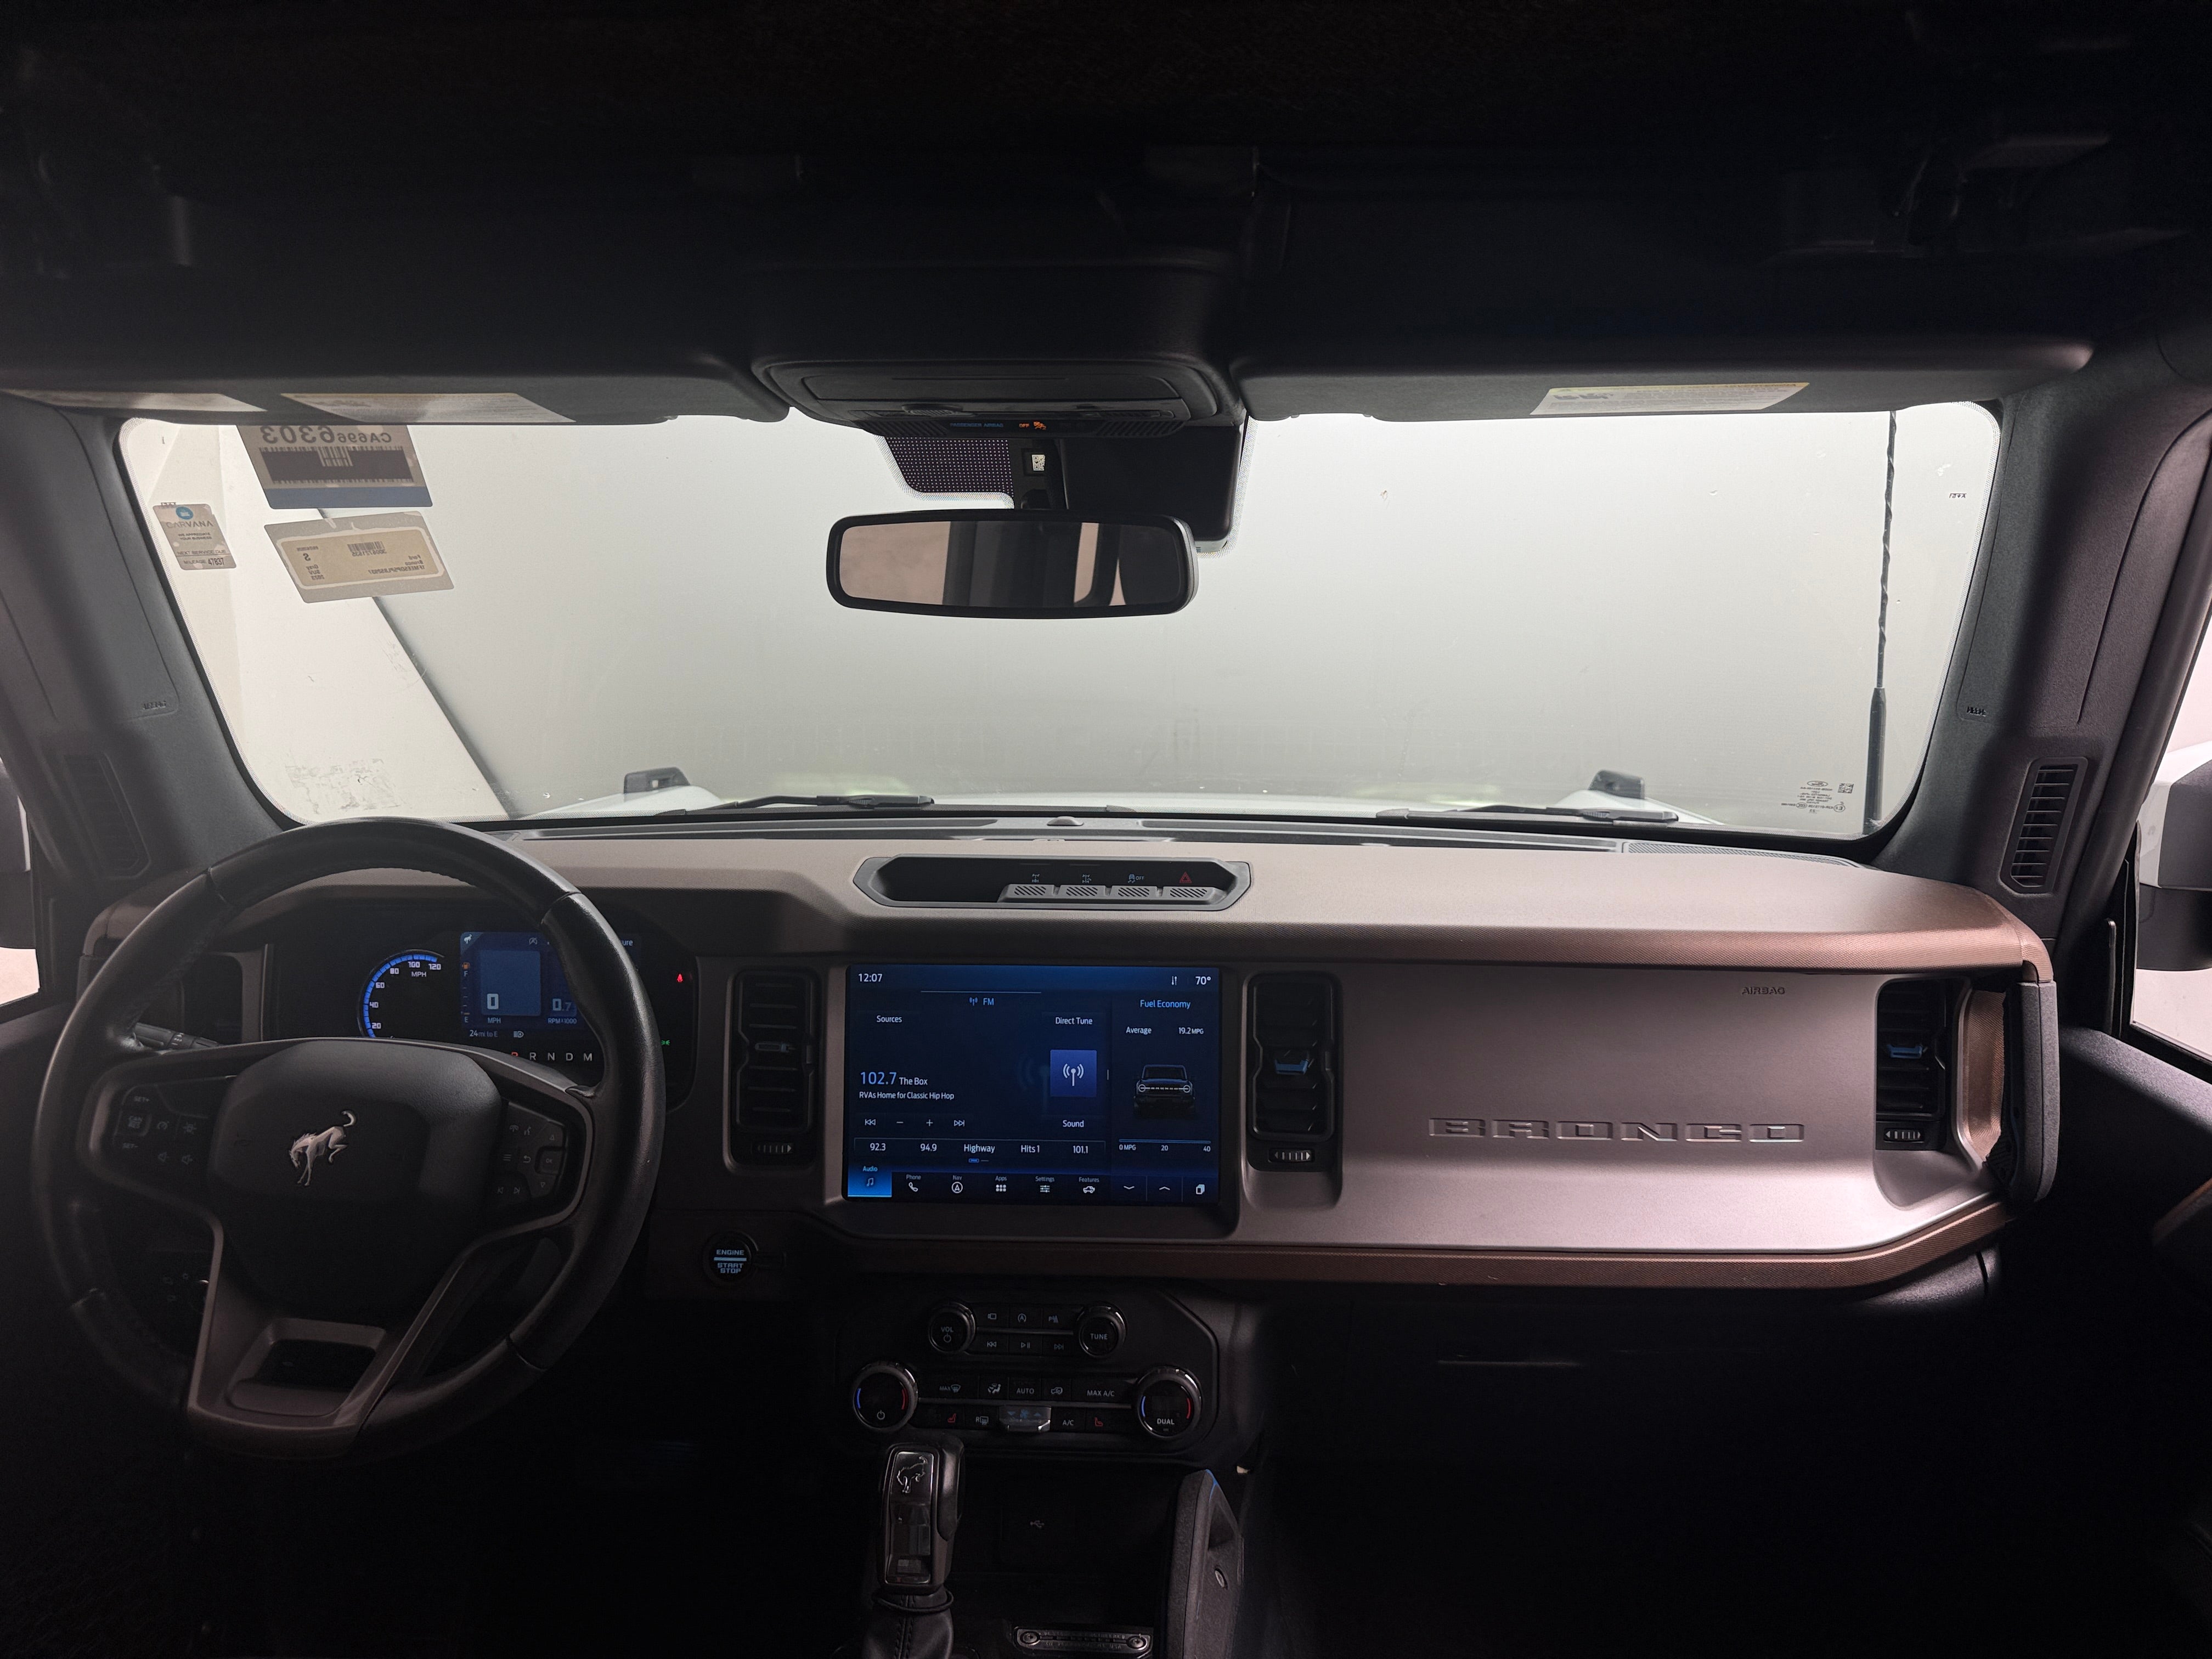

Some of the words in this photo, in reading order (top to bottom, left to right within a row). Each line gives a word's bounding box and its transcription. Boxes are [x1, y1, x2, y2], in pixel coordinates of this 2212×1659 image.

[166, 520, 213, 528] CARVANA
[858, 973, 883, 982] 12:07
[487, 994, 499, 1009] 0
[983, 997, 995, 1006] FM
[1140, 999, 1156, 1008] Fuel
[1157, 1000, 1191, 1009] Economy
[877, 1015, 902, 1023] Sources
[1055, 1017, 1075, 1025] Direct
[1126, 1026, 1152, 1035] Average
[529, 1052, 537, 1060] R
[548, 1052, 555, 1060] N
[566, 1053, 573, 1061] D
[583, 1053, 592, 1062] M
[860, 1071, 897, 1085] 102.7
[899, 1077, 913, 1085] The
[929, 1092, 940, 1100] Hip
[1062, 1120, 1085, 1128] Sound
[1429, 1118, 1805, 1143] BRONCO
[870, 1143, 887, 1151] 92.3
[920, 1143, 938, 1152] 94.9
[964, 1143, 995, 1154] Highway
[1021, 1144, 1035, 1153] Hits
[1073, 1145, 1088, 1154] 101.1
[1015, 1387, 1035, 1395] AUTO
[1102, 1389, 1115, 1397] A/C
[1062, 1418, 1075, 1426] A/C
[1156, 1418, 1175, 1426] DUAL
